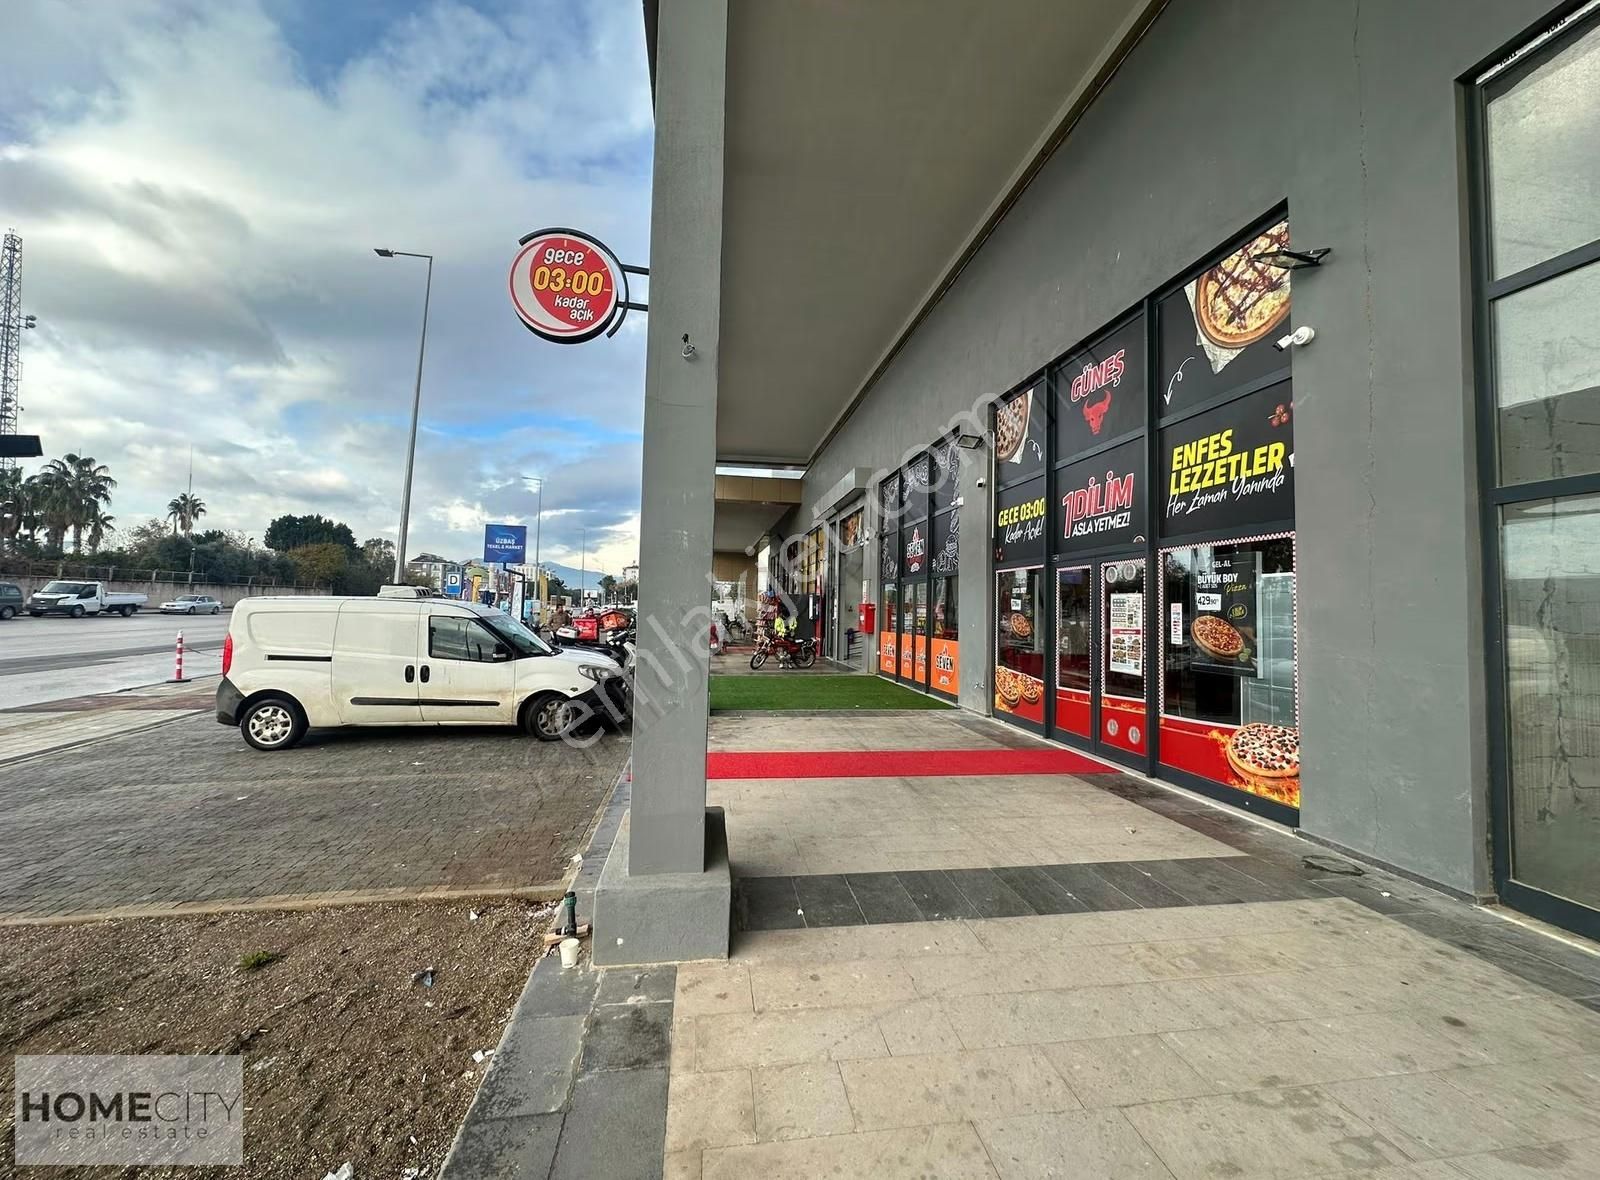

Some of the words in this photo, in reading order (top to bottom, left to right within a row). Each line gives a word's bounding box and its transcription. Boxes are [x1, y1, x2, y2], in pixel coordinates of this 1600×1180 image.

[544, 249, 584, 265] gece
[533, 266, 604, 296] 03:00
[554, 295, 590, 309] kadar
[569, 308, 594, 323] açık
[1071, 349, 1125, 402] GÜNEŞ
[1171, 428, 1233, 471] ENFES
[1169, 442, 1285, 496] LEZZETLER
[1166, 493, 1187, 518] Her
[1185, 487, 1228, 514] Zaman
[1231, 464, 1285, 501] Yanında
[998, 505, 1020, 527] GECE
[1020, 497, 1045, 521] 03:00
[1197, 571, 1222, 584] BÜYÜK
[1222, 573, 1239, 583] BOY
[936, 654, 954, 672] SEVEN
